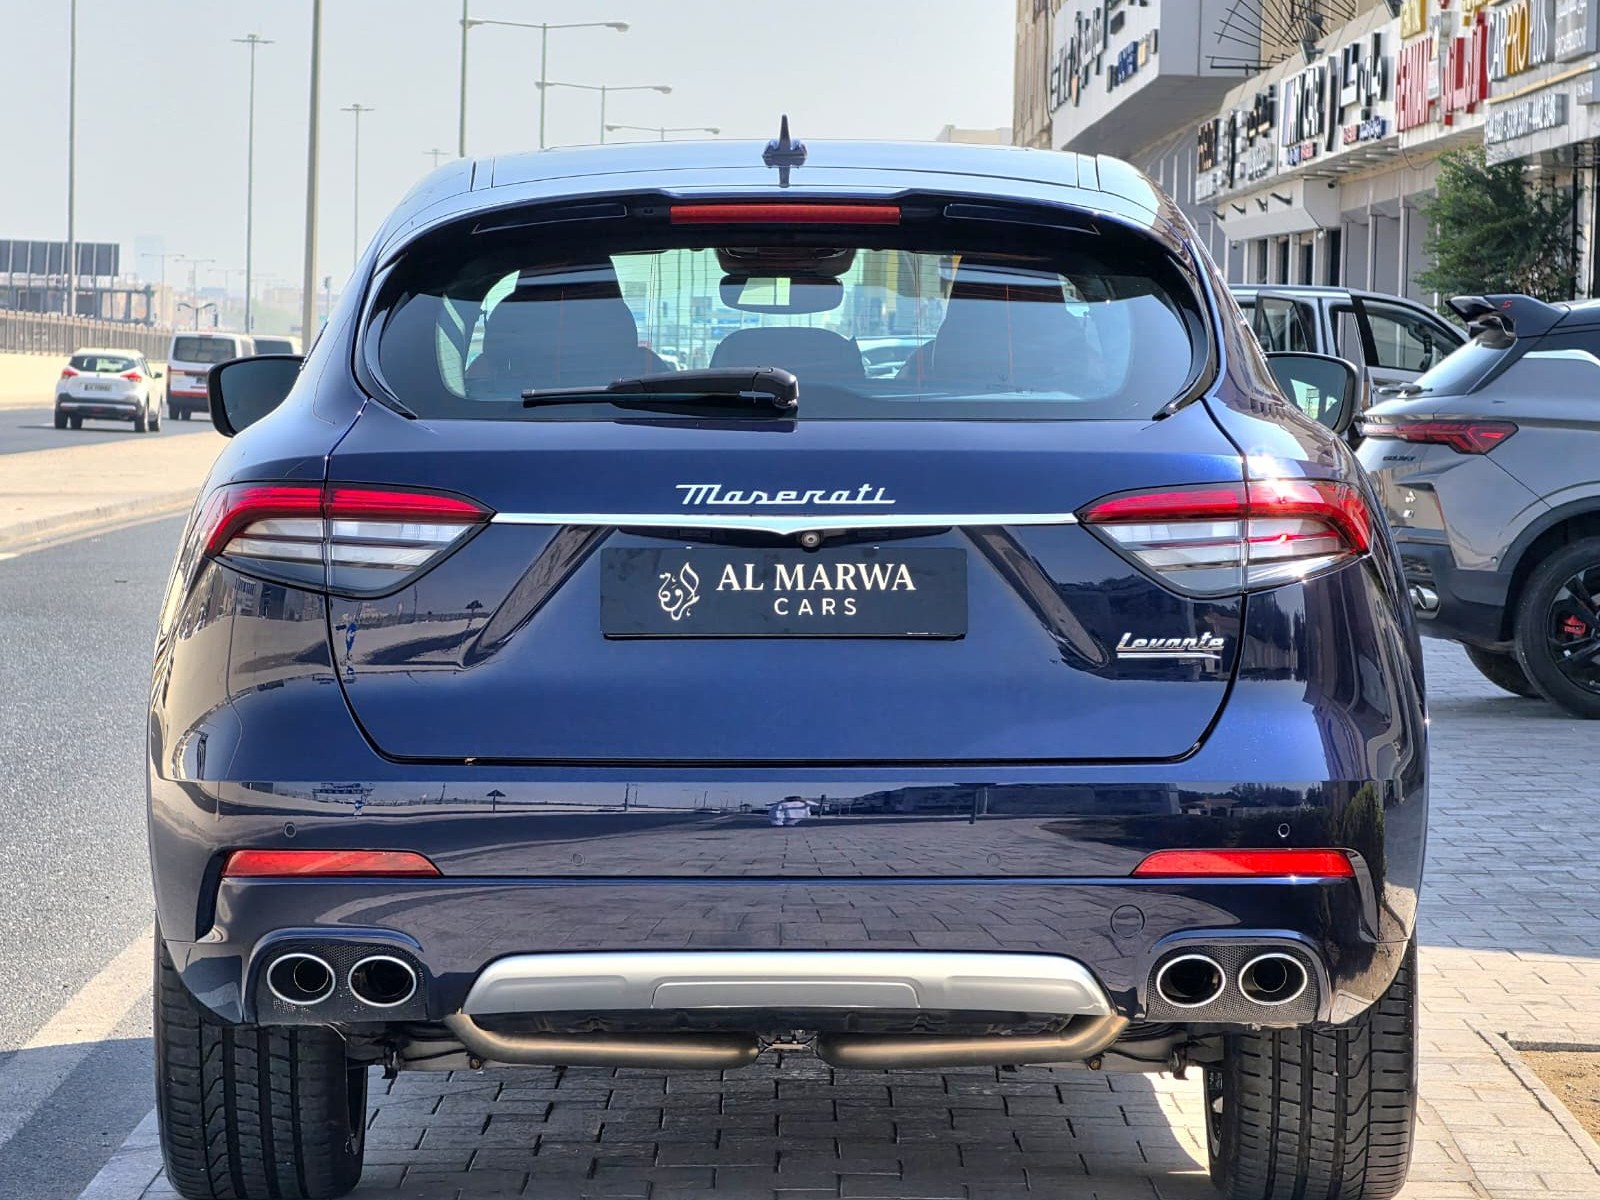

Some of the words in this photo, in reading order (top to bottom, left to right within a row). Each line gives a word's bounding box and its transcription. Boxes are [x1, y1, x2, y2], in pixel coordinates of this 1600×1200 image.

[676, 483, 896, 505] Maserati
[716, 563, 764, 591] AL
[774, 563, 917, 591] MARWA
[774, 598, 857, 616] CARS
[1115, 631, 1226, 653] Levante
